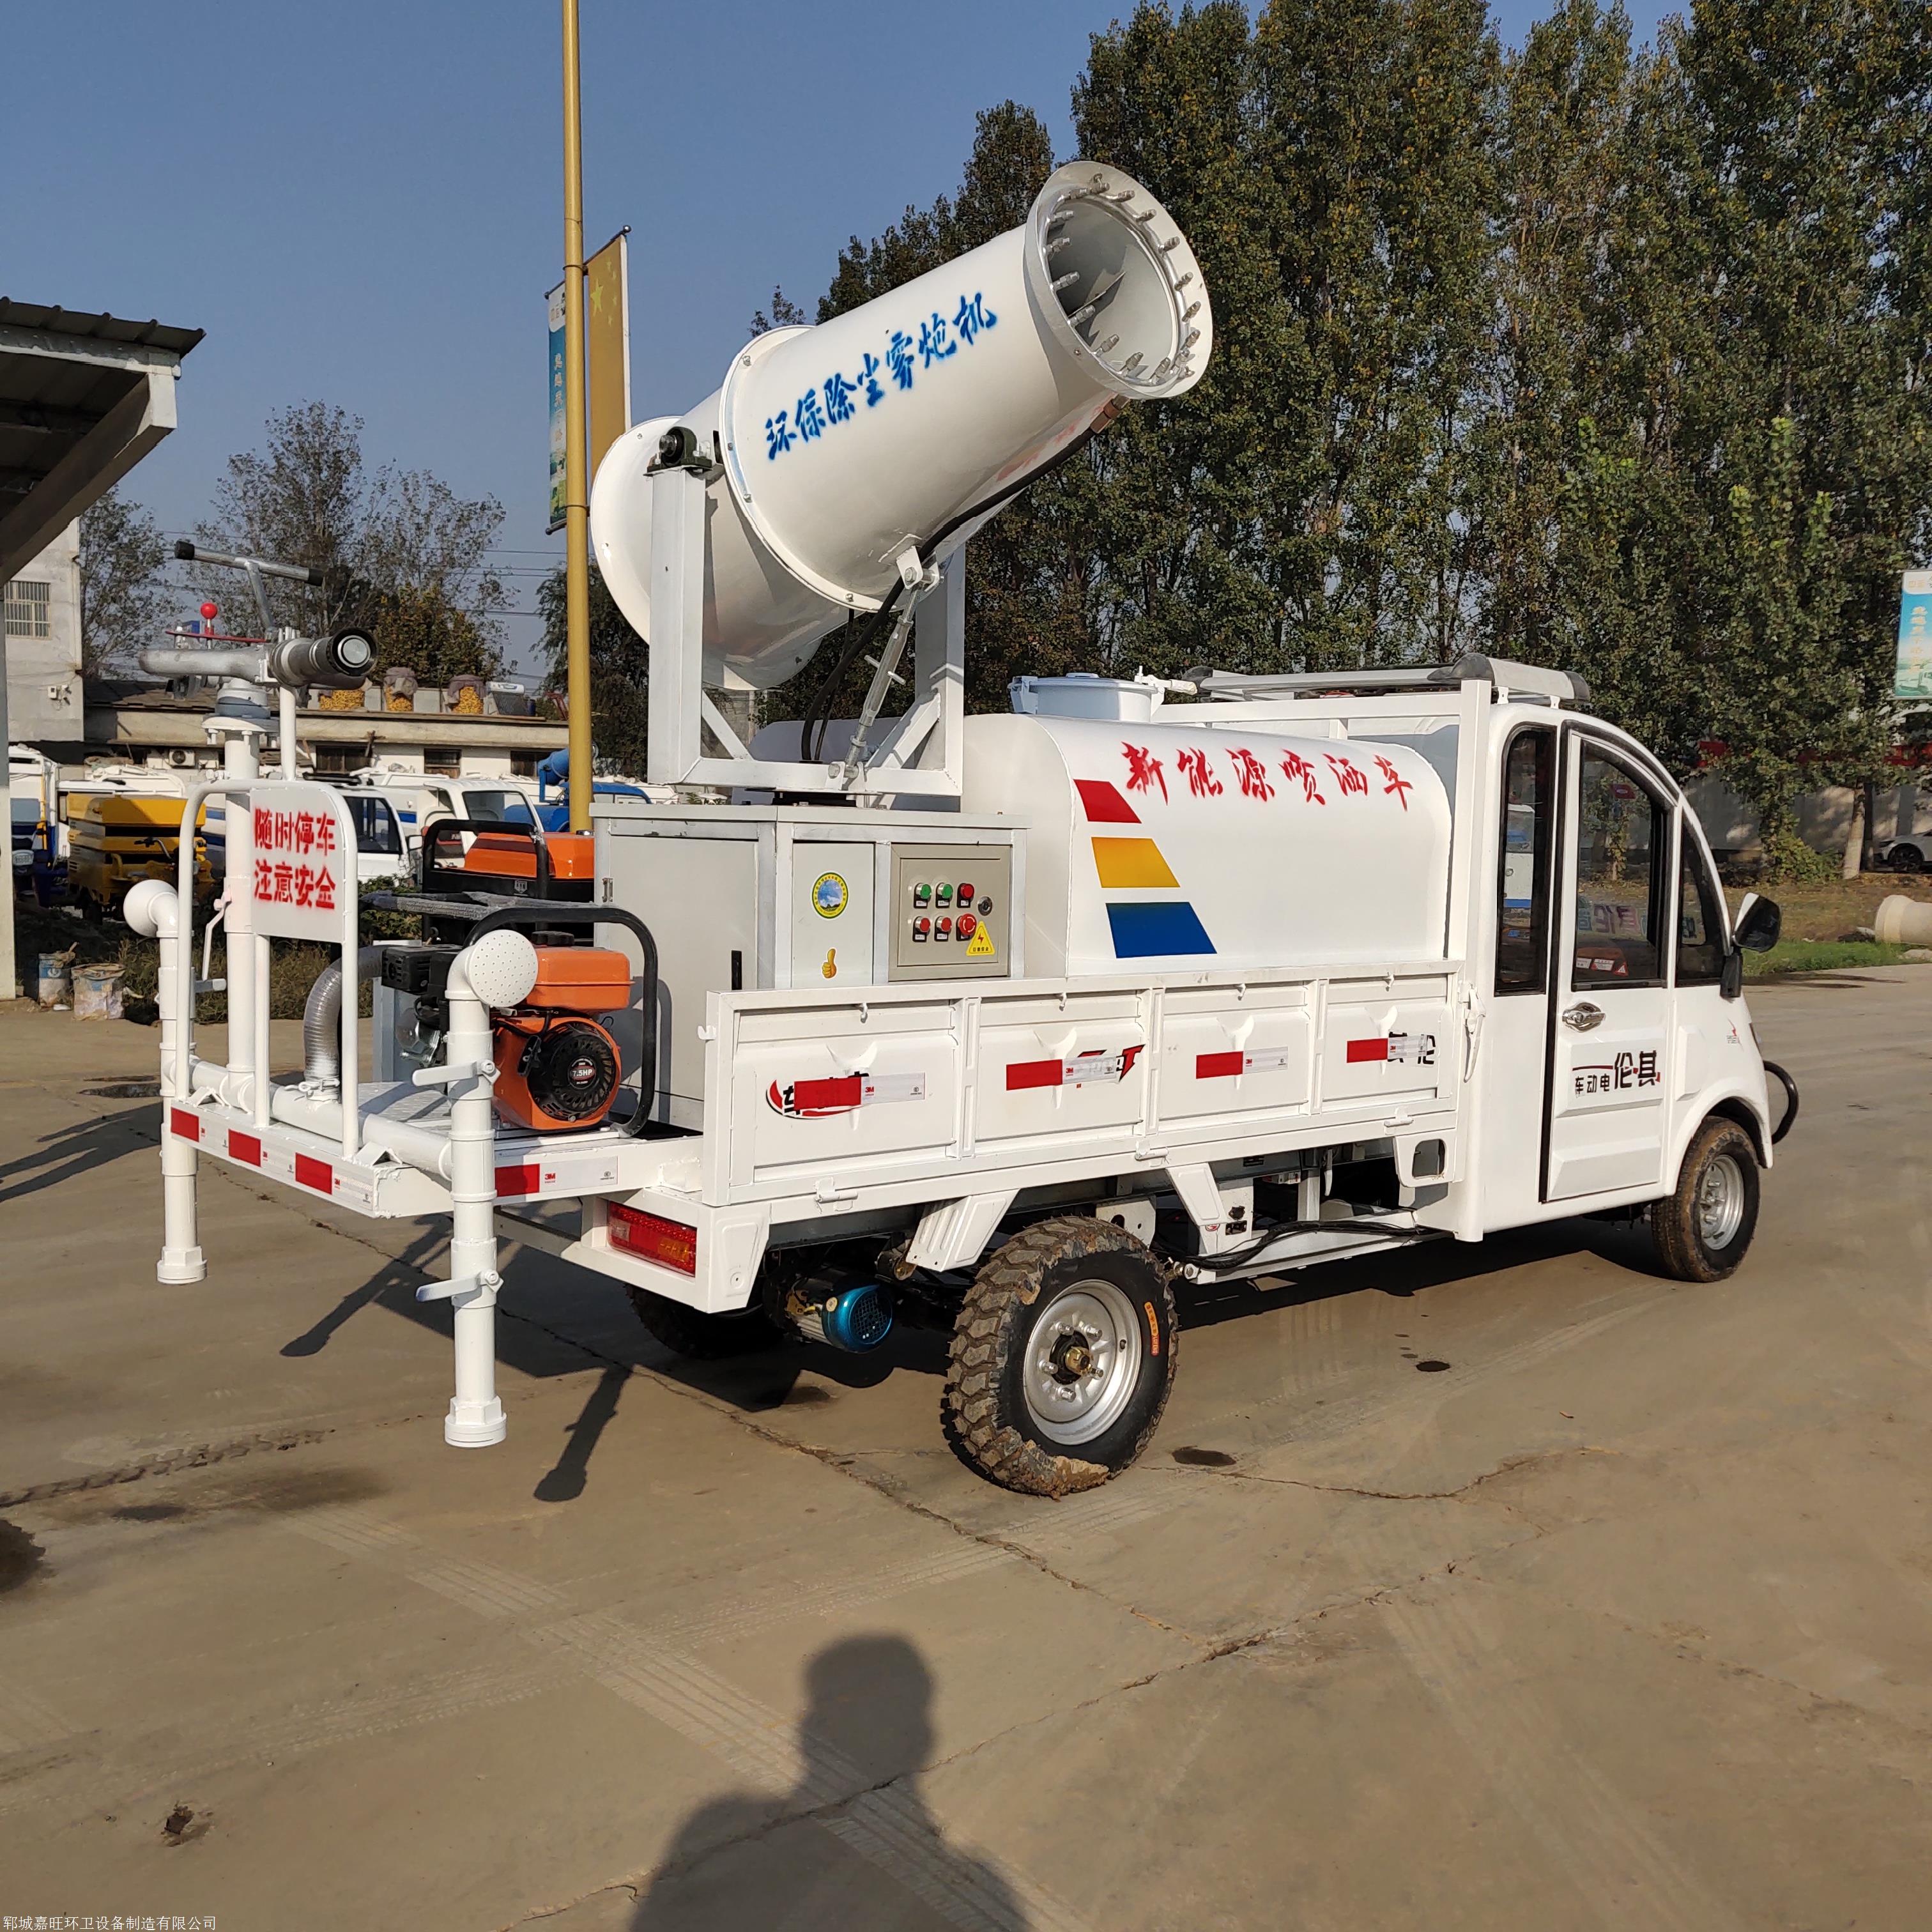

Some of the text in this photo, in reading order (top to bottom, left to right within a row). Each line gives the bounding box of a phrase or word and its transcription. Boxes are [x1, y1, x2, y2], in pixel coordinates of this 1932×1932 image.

[765, 291, 998, 461] 环保除尘雾炮机
[1121, 742, 1413, 812] 新能源喷洒车
[254, 808, 336, 857] 随时停车
[254, 859, 337, 910] 注意安全
[572, 1068, 593, 1078] 7.5HP
